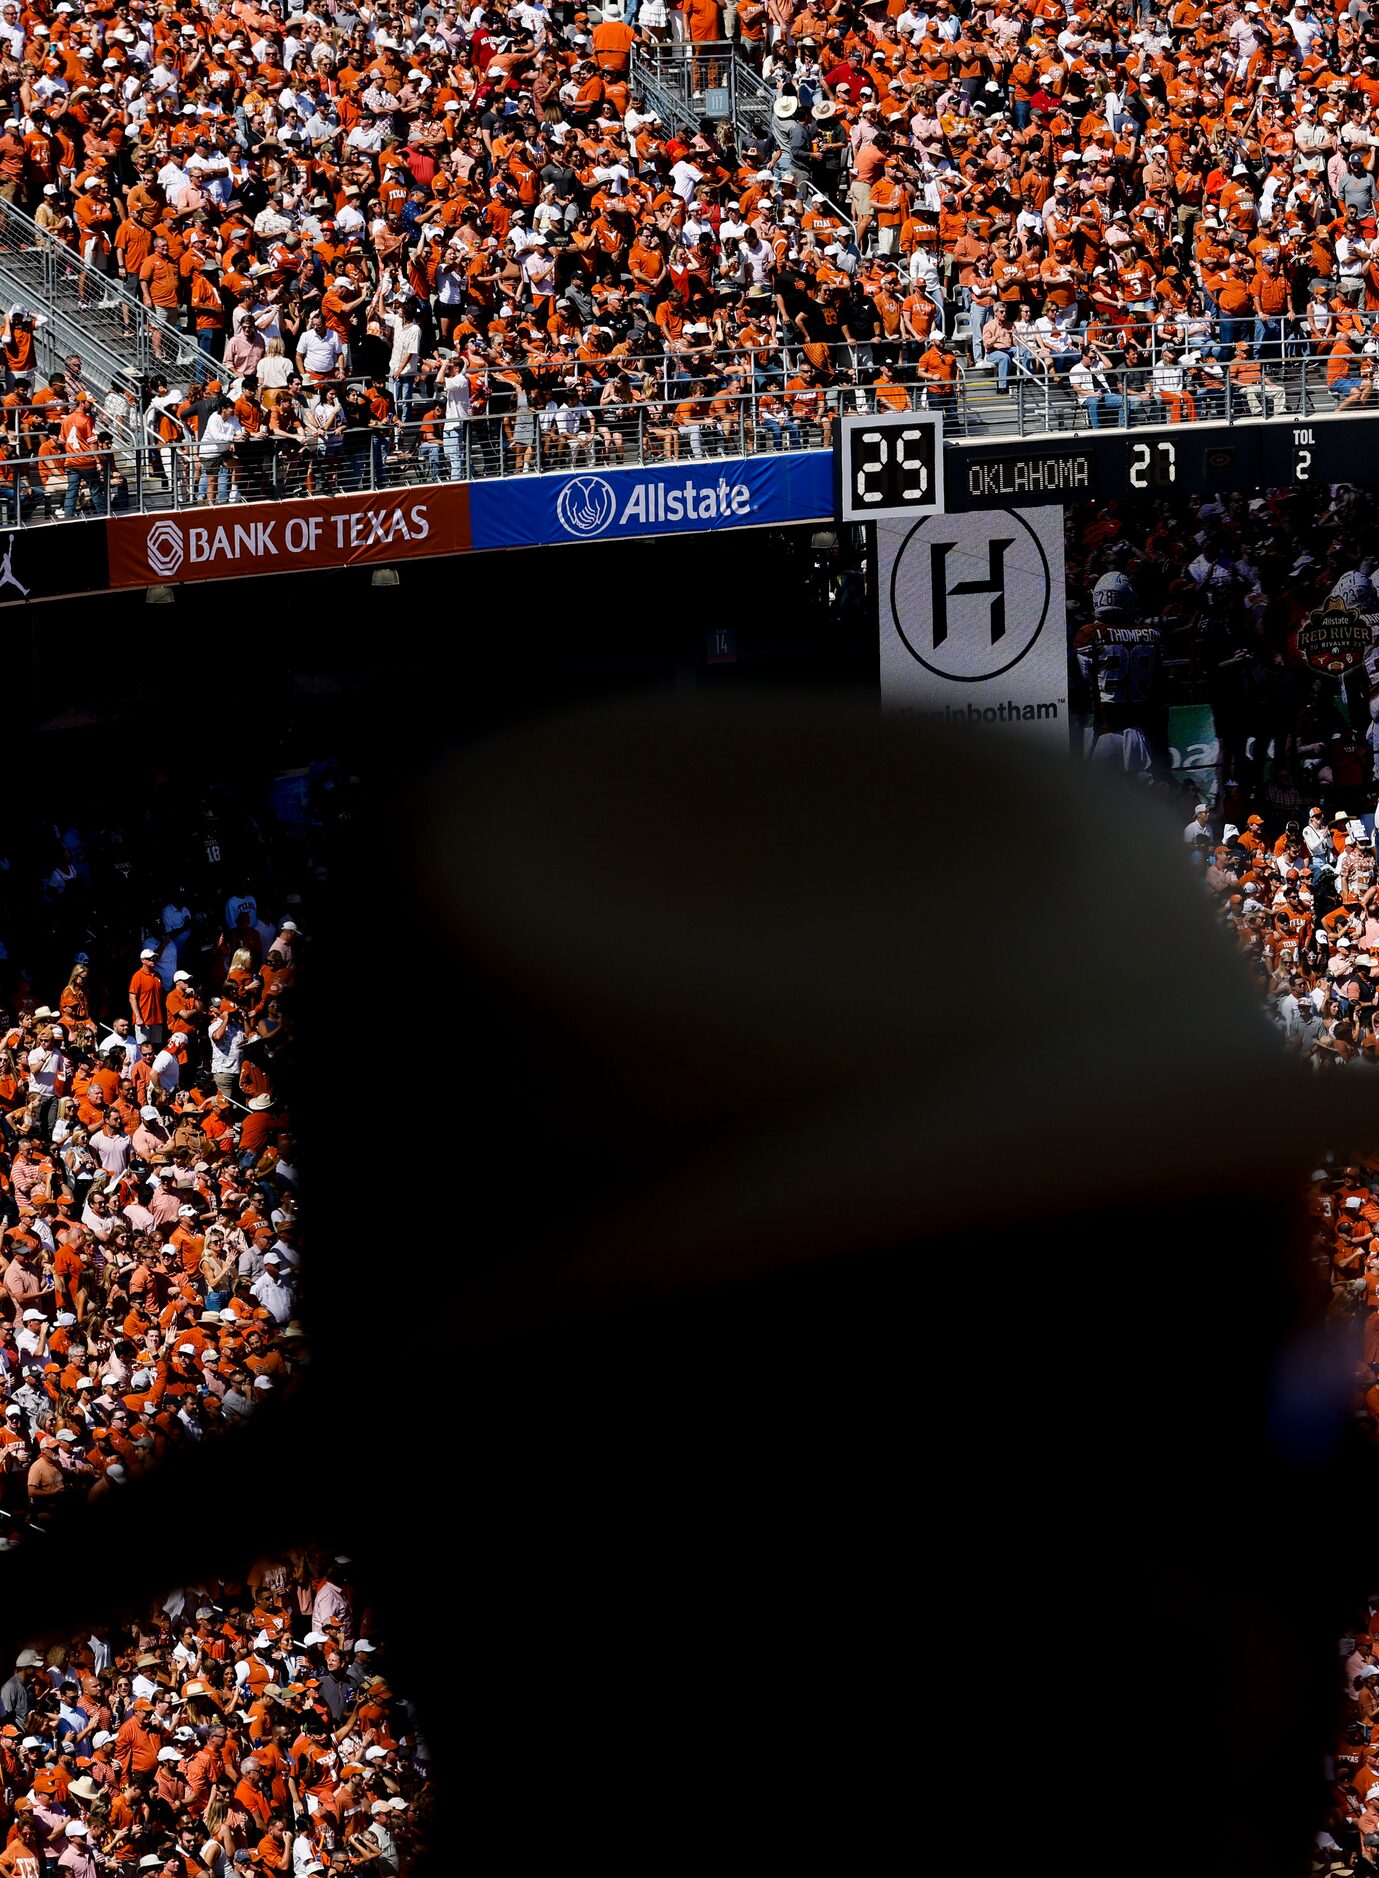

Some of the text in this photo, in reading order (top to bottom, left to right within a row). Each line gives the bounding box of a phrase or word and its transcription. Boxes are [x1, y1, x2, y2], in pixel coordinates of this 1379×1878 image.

[710, 96, 723, 110] 117
[1130, 279, 1141, 295] 3
[826, 312, 837, 324] 83
[1293, 429, 1315, 445] TOL
[857, 430, 928, 502] 25
[1129, 442, 1176, 488] 27
[1296, 450, 1310, 480] 2
[969, 458, 1089, 496] OKLAHOMA
[619, 478, 751, 525] Allstate
[189, 505, 429, 563] BANK OF TEXAS
[931, 537, 1016, 650] H
[1322, 616, 1349, 626] Allstate
[715, 634, 729, 653] 14
[1301, 627, 1370, 645] RED RIVER
[1323, 1201, 1332, 1216] 3
[253, 1221, 269, 1229] TEXAS
[1338, 1755, 1359, 1763] TEXAS
